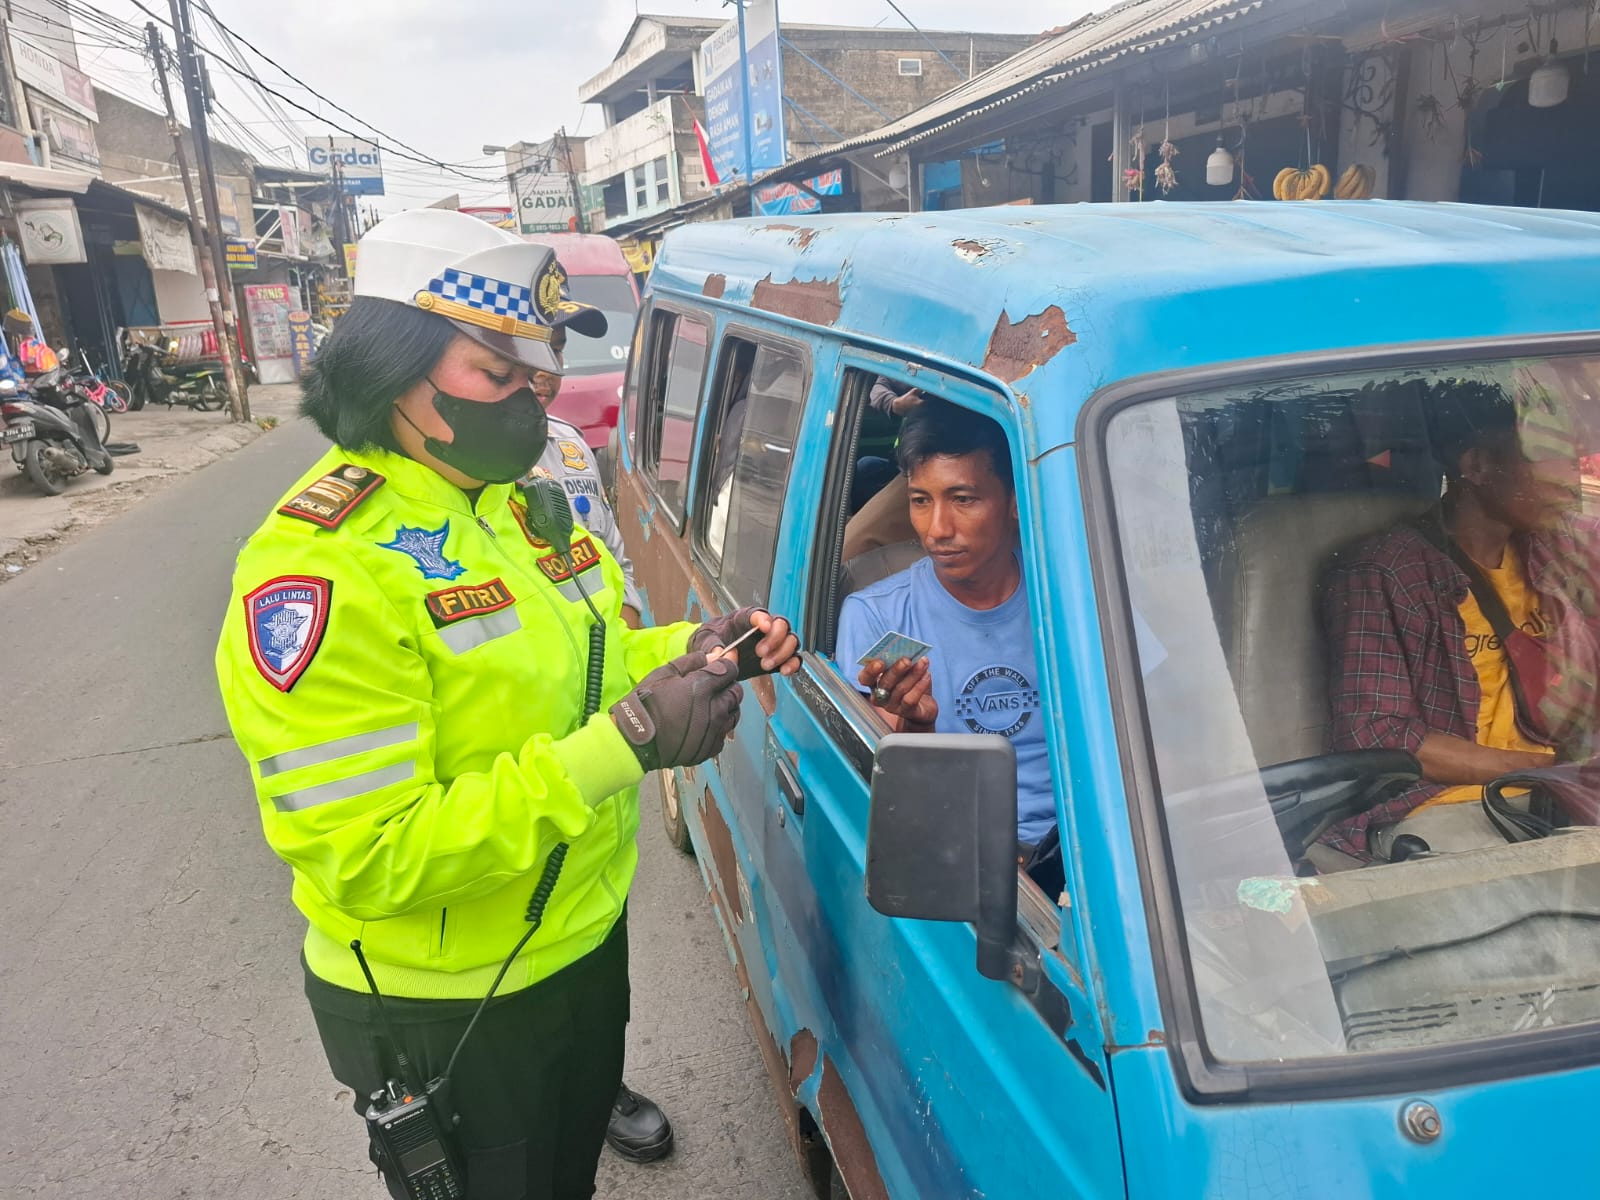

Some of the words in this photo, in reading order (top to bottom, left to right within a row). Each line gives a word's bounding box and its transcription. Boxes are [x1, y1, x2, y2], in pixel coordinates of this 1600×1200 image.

[310, 147, 378, 165] Gadai
[522, 196, 573, 209] GADAI
[291, 498, 335, 517] POLISI
[259, 593, 279, 607] LALU
[283, 591, 312, 600] LINTAS
[438, 585, 504, 615] FITRI
[967, 676, 980, 690] OFF
[983, 668, 1000, 678] THE
[1005, 669, 1026, 686] WALL
[974, 690, 1019, 713] VANS
[620, 701, 645, 732] EIGER
